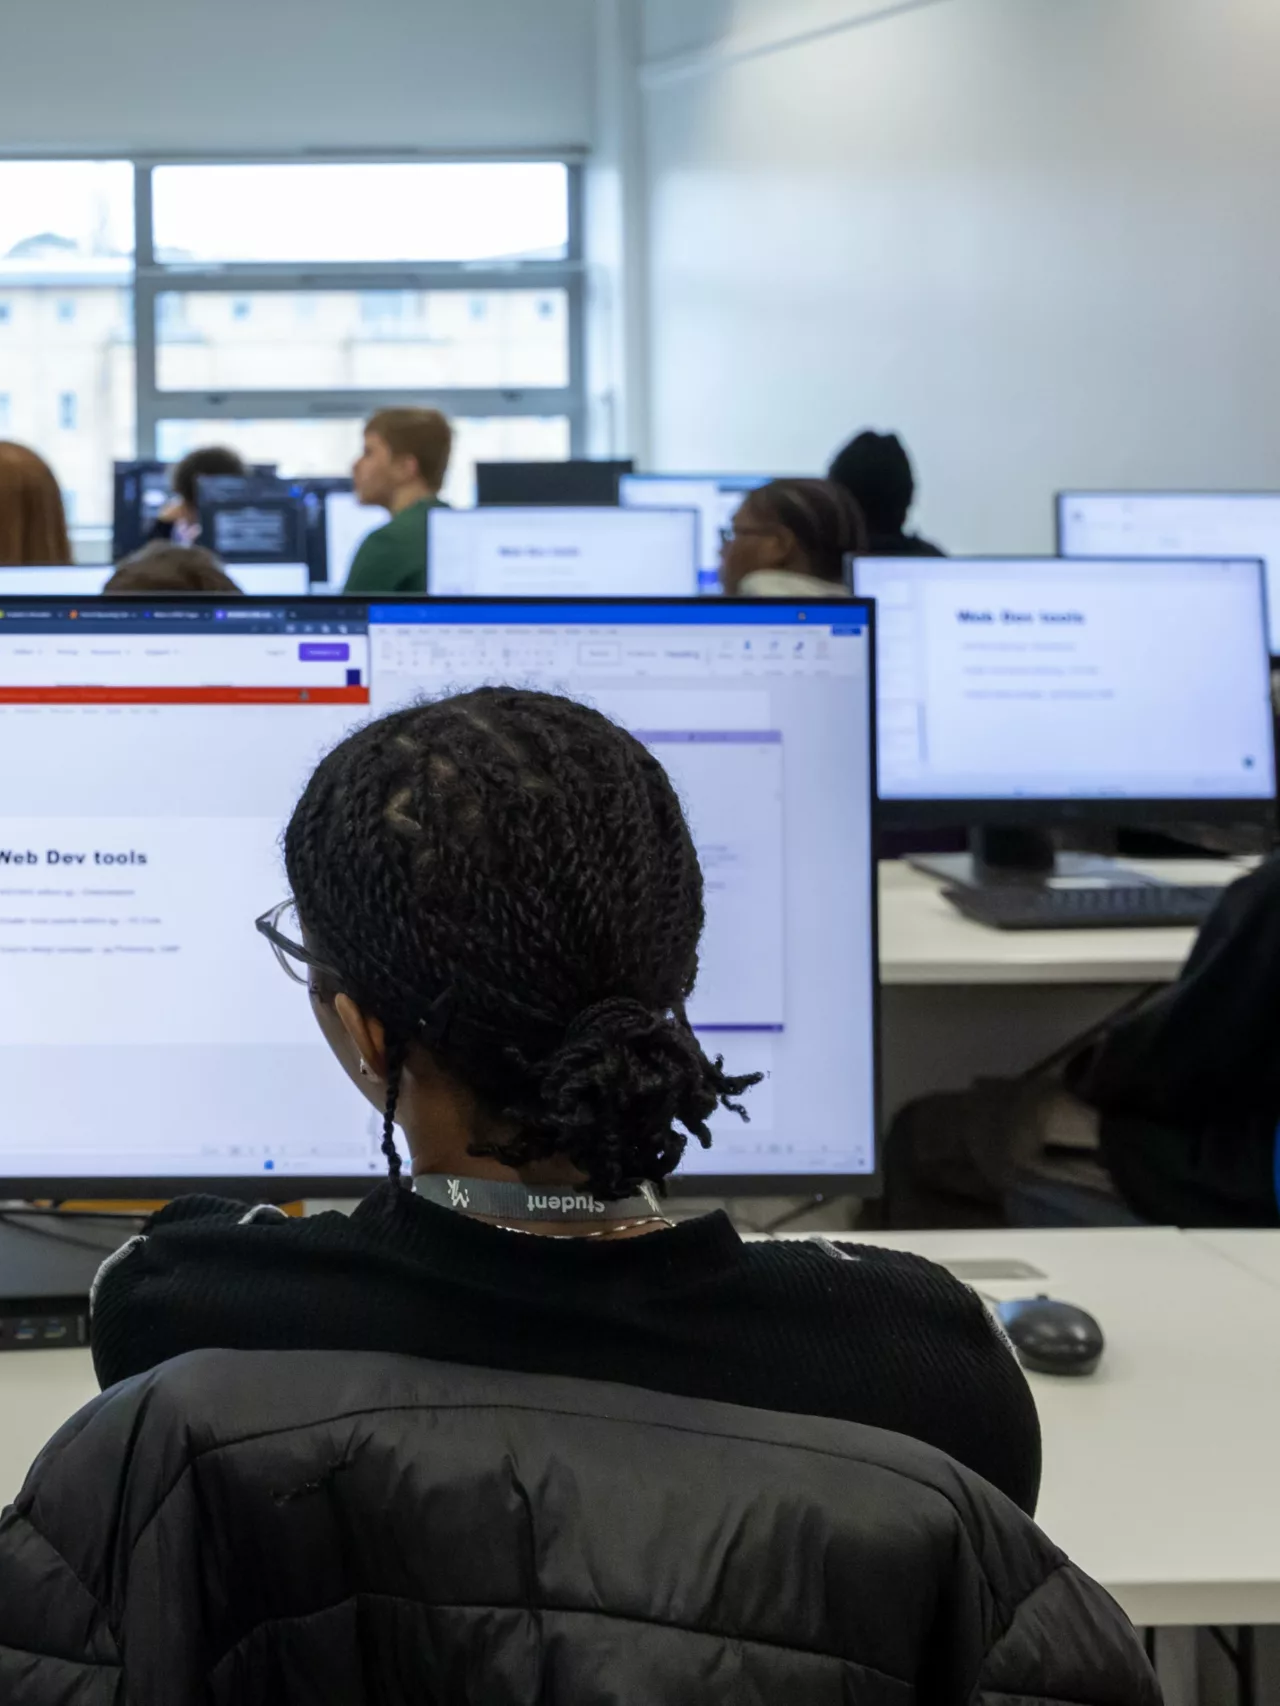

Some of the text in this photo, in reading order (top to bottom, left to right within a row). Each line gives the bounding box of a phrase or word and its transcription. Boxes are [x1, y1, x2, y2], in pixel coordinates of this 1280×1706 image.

[46, 849, 85, 865] Dev
[95, 849, 148, 865] tools
[527, 1194, 605, 1213] Student
